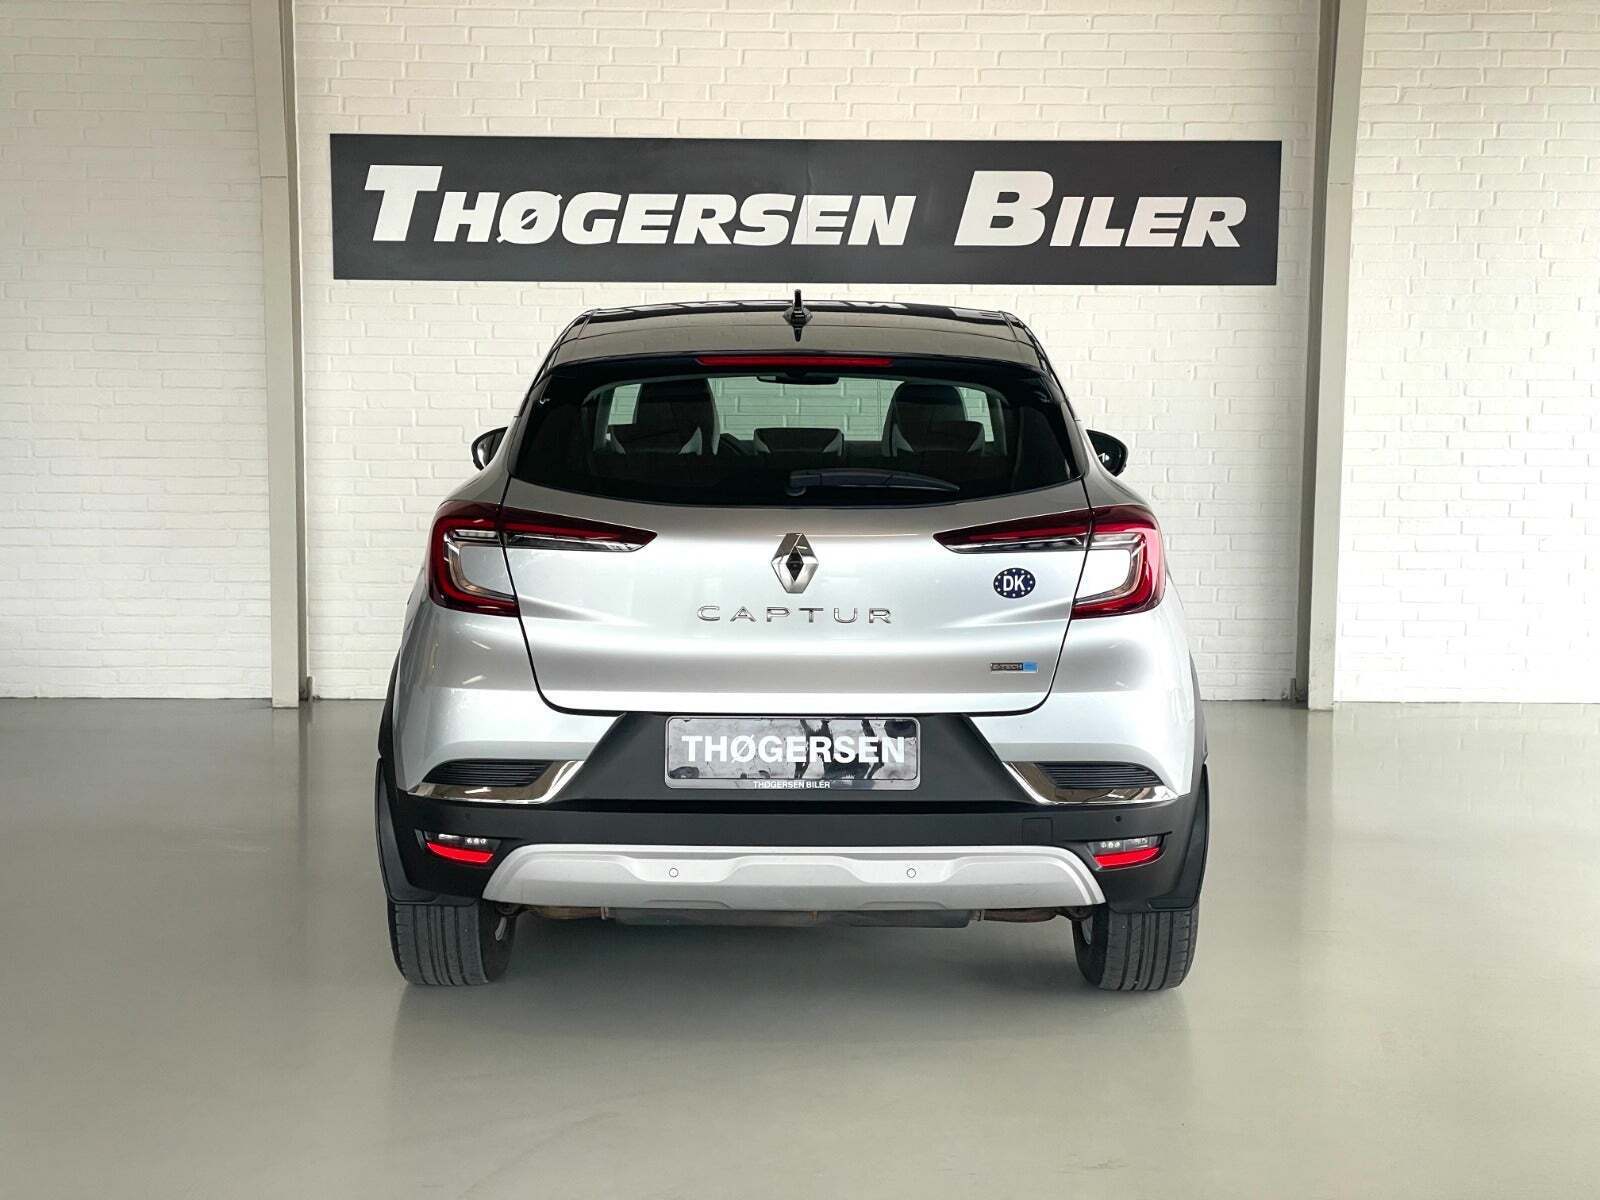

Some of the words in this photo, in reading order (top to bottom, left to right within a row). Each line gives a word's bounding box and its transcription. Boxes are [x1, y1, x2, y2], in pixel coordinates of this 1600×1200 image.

[364, 164, 917, 247] THØGERSEN
[954, 170, 1247, 248] BILER
[1003, 575, 1026, 592] DK
[696, 605, 892, 624] CAPTUR
[681, 734, 906, 764] THØGERSEN
[753, 780, 805, 789] THØGERSEN
[806, 780, 831, 789] BILER
